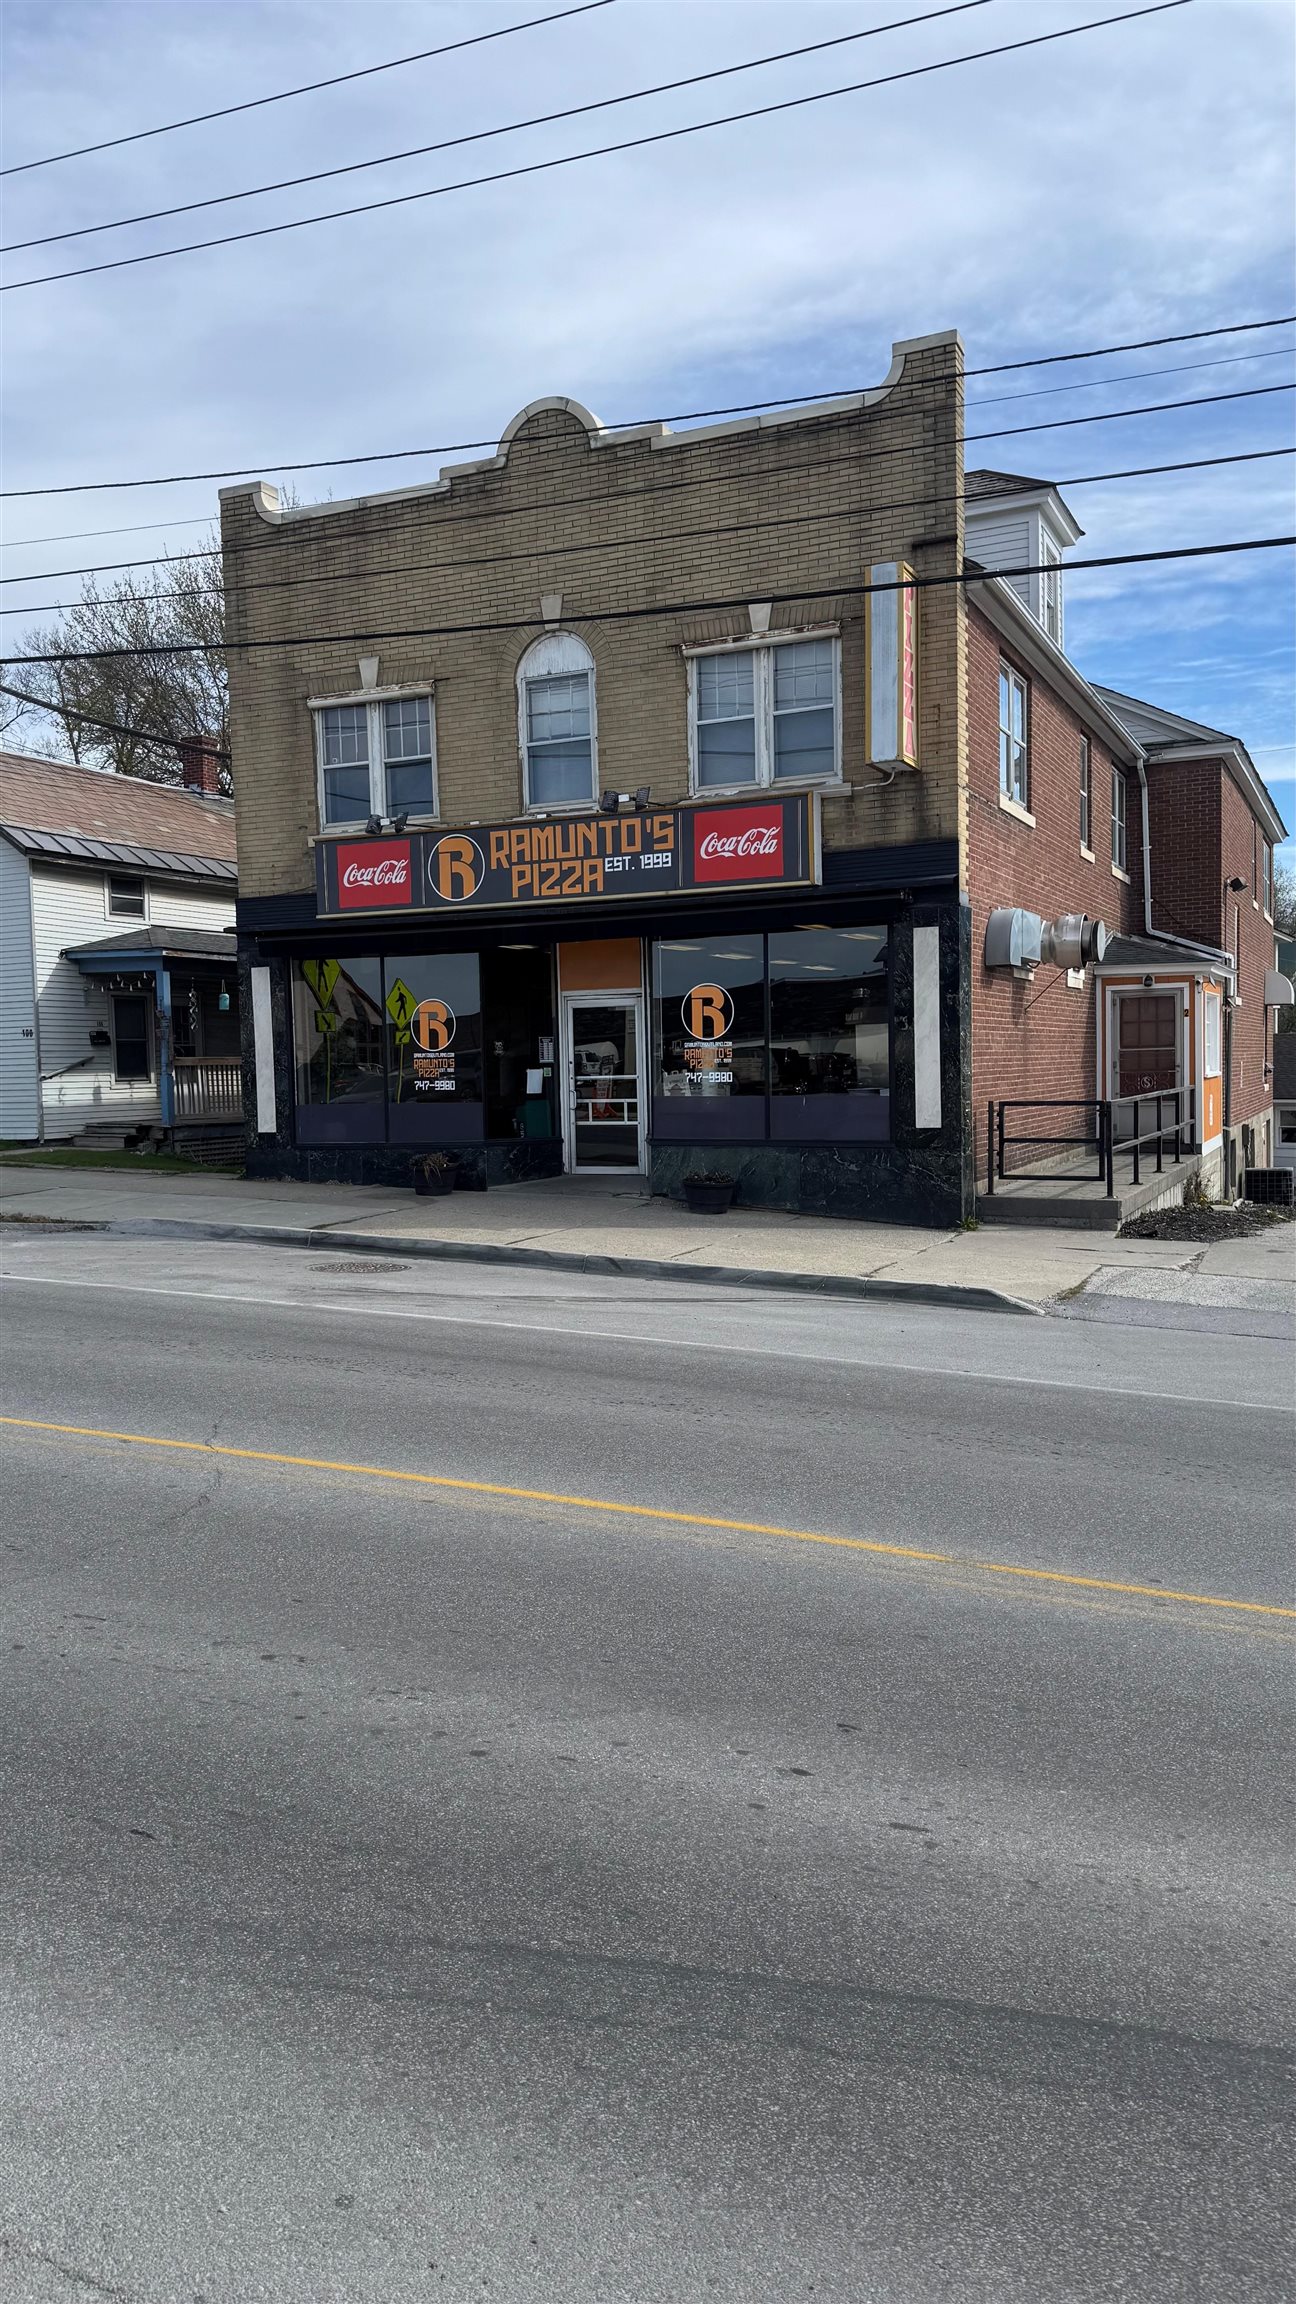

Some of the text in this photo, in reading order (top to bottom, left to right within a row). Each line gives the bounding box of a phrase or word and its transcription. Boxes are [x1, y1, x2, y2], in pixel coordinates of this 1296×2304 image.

[489, 814, 674, 870] RAMUNTO'S
[700, 826, 781, 859] Coca-Cola
[343, 859, 409, 888] Coca-Cola
[438, 837, 475, 899] R
[604, 852, 672, 872] EST. 1999
[511, 858, 604, 898] PIZZA
[418, 1001, 448, 1050] R
[691, 986, 725, 1038] R
[1184, 1008, 1189, 1017] 2
[413, 1058, 455, 1070] RAMUNTO'S
[418, 1068, 440, 1078] PIZZA
[685, 1071, 733, 1083] 747-9980
[414, 1080, 456, 1091] 747-9980
